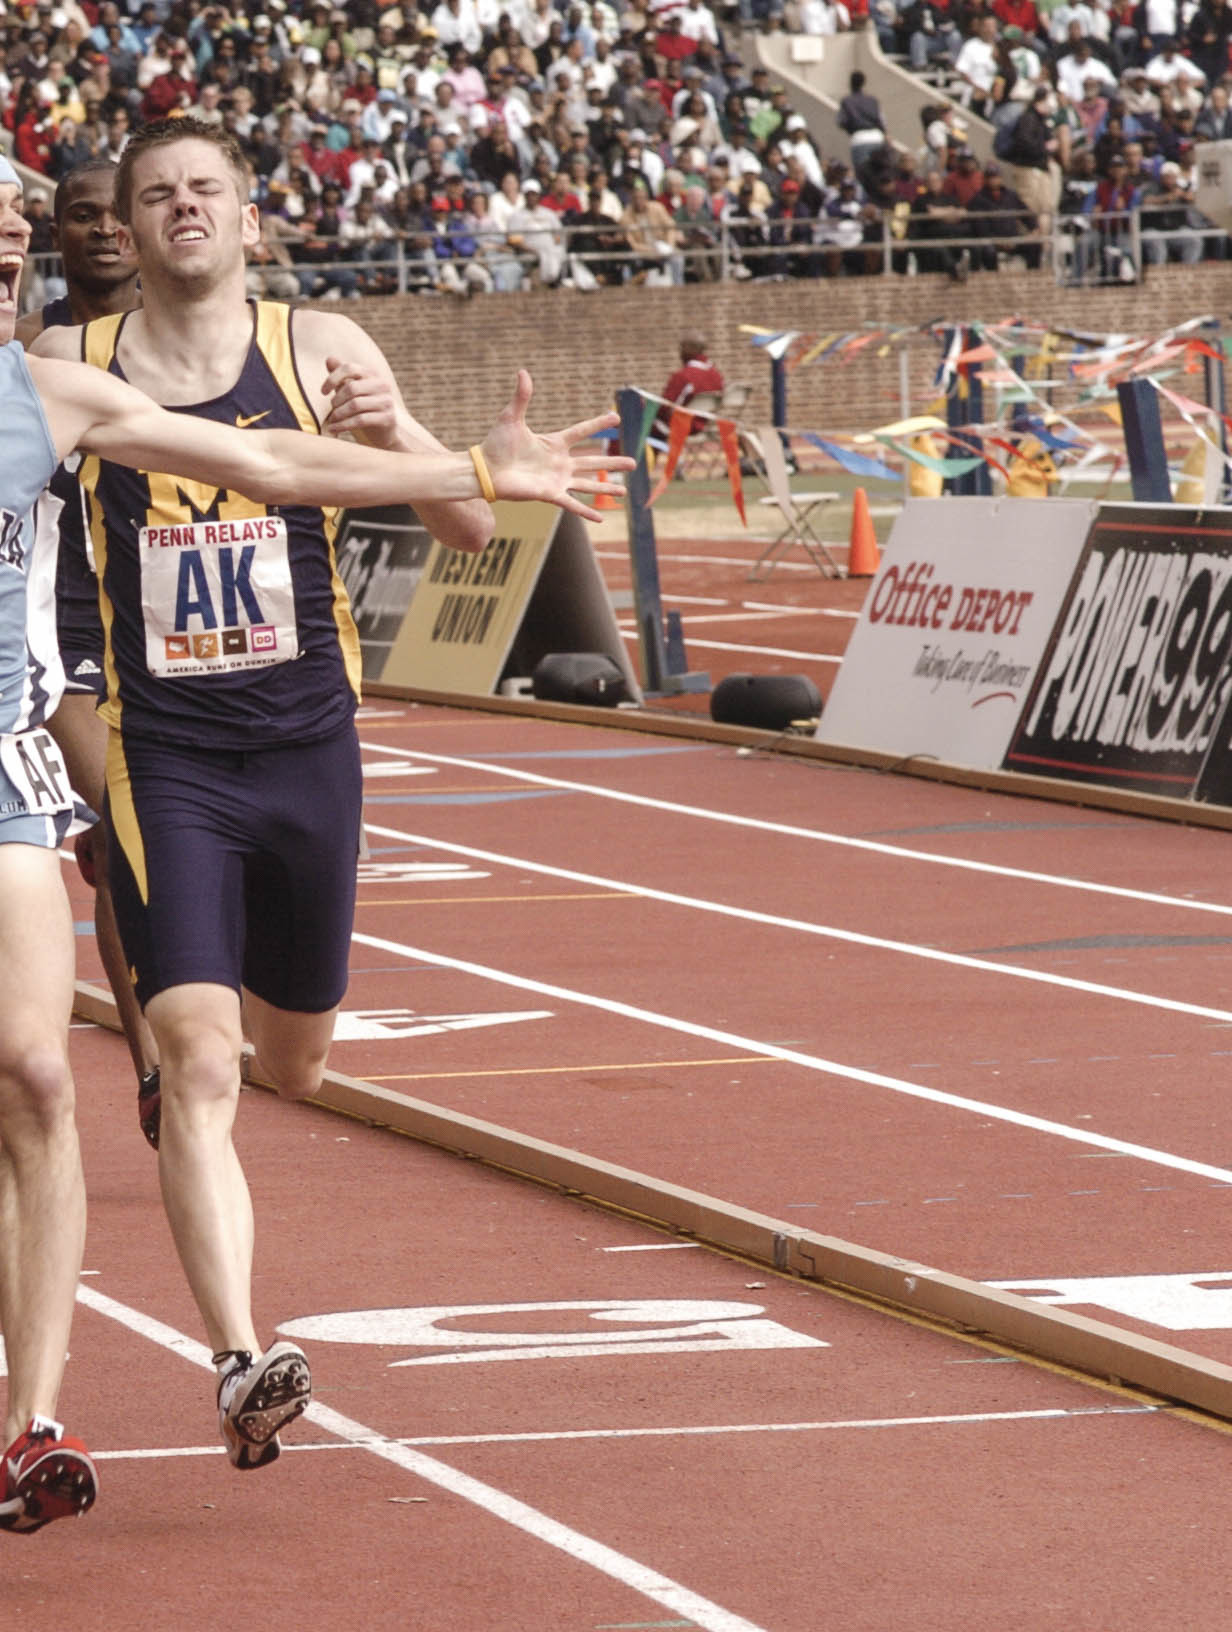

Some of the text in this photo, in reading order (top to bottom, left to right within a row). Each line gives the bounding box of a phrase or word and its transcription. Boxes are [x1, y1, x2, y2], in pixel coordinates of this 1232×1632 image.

[147, 519, 278, 548] PENN RELAYS
[429, 538, 521, 588] WESTERN
[174, 545, 265, 632] AK
[431, 594, 499, 645] UNION
[869, 561, 1035, 636] Office DEPOT
[15, 734, 66, 808] AF
[275, 1300, 831, 1367] 5
